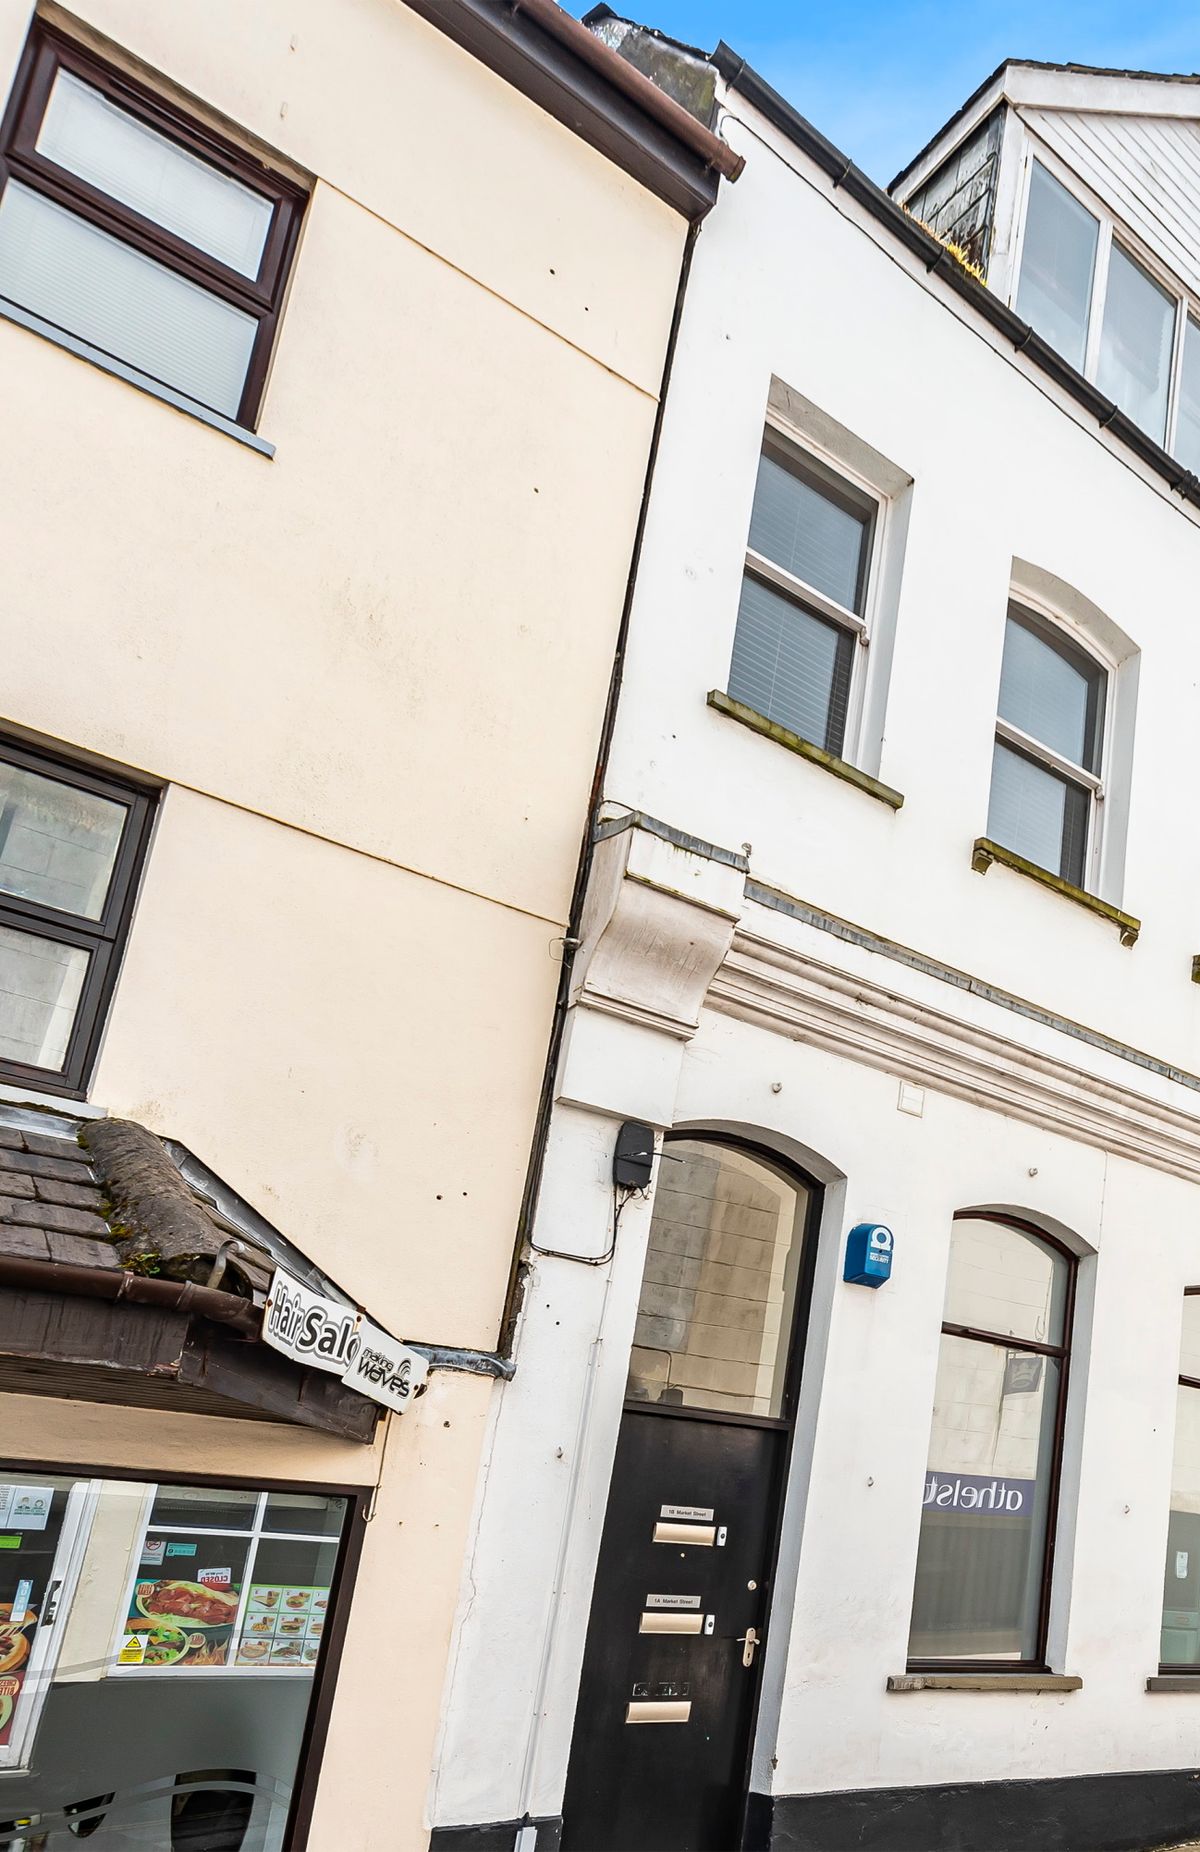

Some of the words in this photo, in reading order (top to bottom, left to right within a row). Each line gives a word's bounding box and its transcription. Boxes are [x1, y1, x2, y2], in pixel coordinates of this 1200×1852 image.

[269, 1282, 304, 1345] Hair
[357, 1357, 411, 1399] waves
[362, 1348, 395, 1372] making
